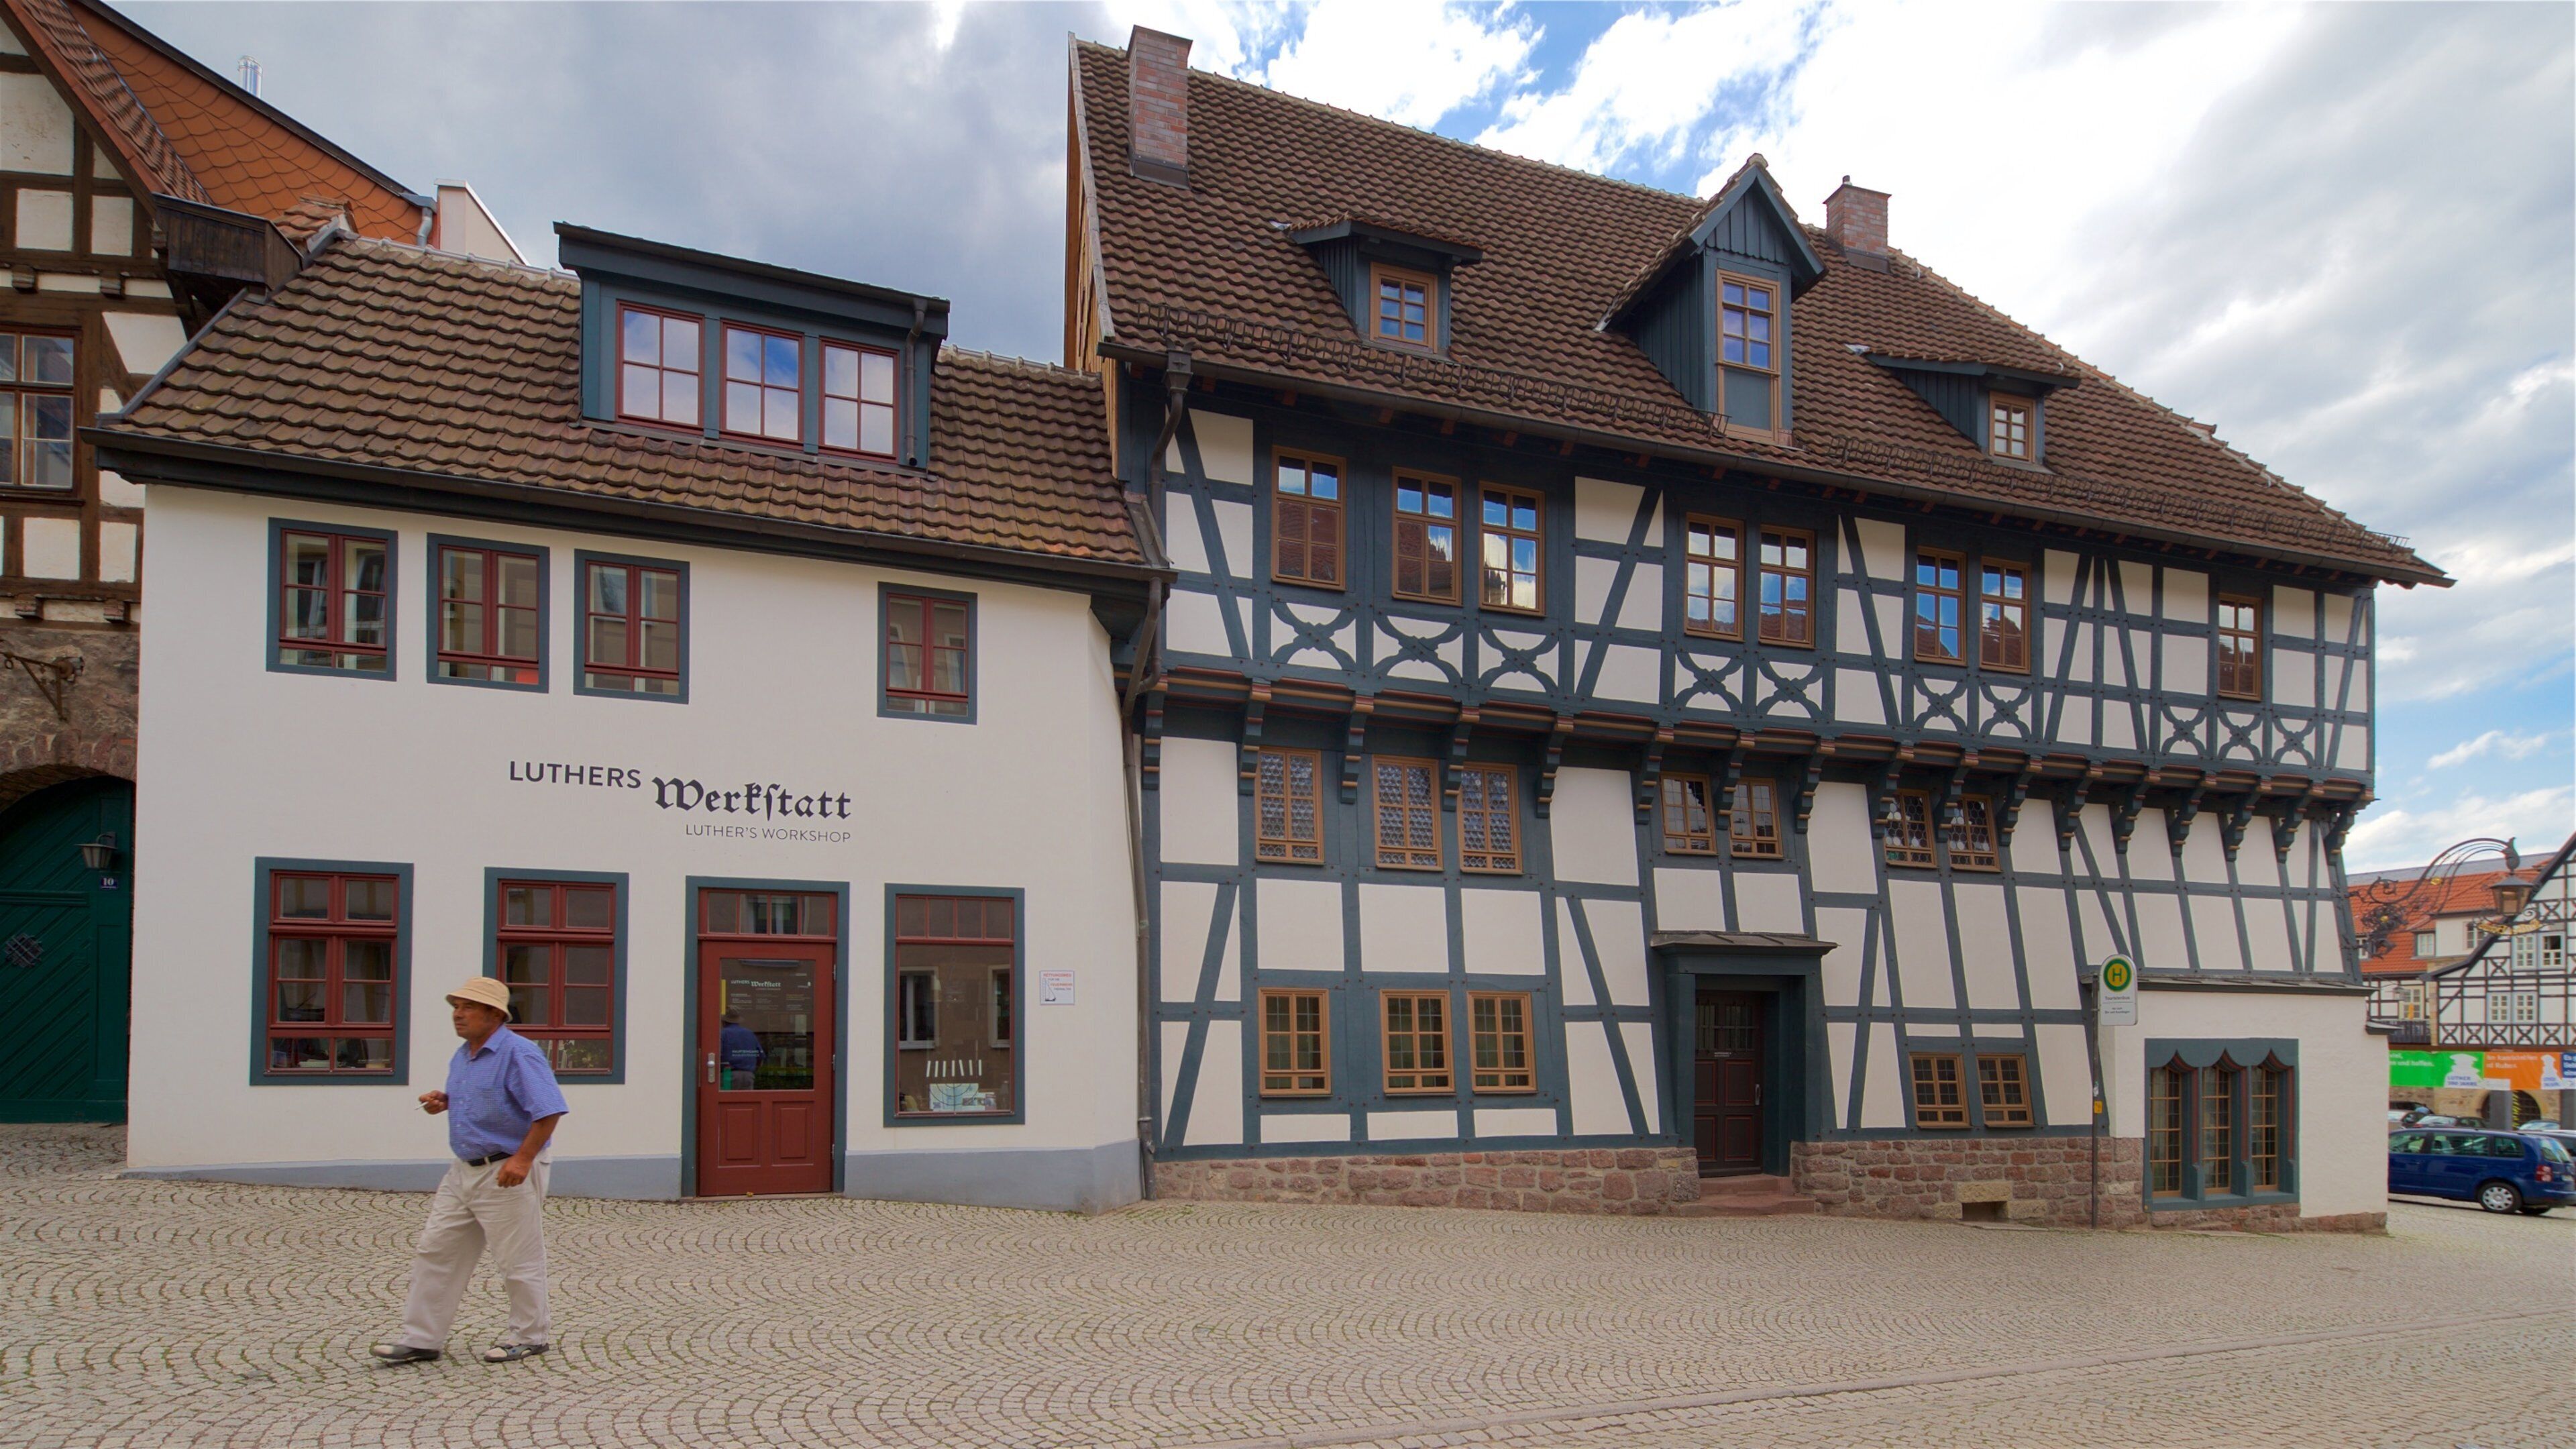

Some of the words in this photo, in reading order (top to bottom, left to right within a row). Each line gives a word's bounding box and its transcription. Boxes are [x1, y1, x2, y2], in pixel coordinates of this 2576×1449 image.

[510, 761, 641, 789] LUTHERS
[686, 824, 757, 839] LUTHER'S
[761, 828, 851, 843] WORKSHOP
[103, 877, 114, 886] 10
[2112, 968, 2122, 982] H
